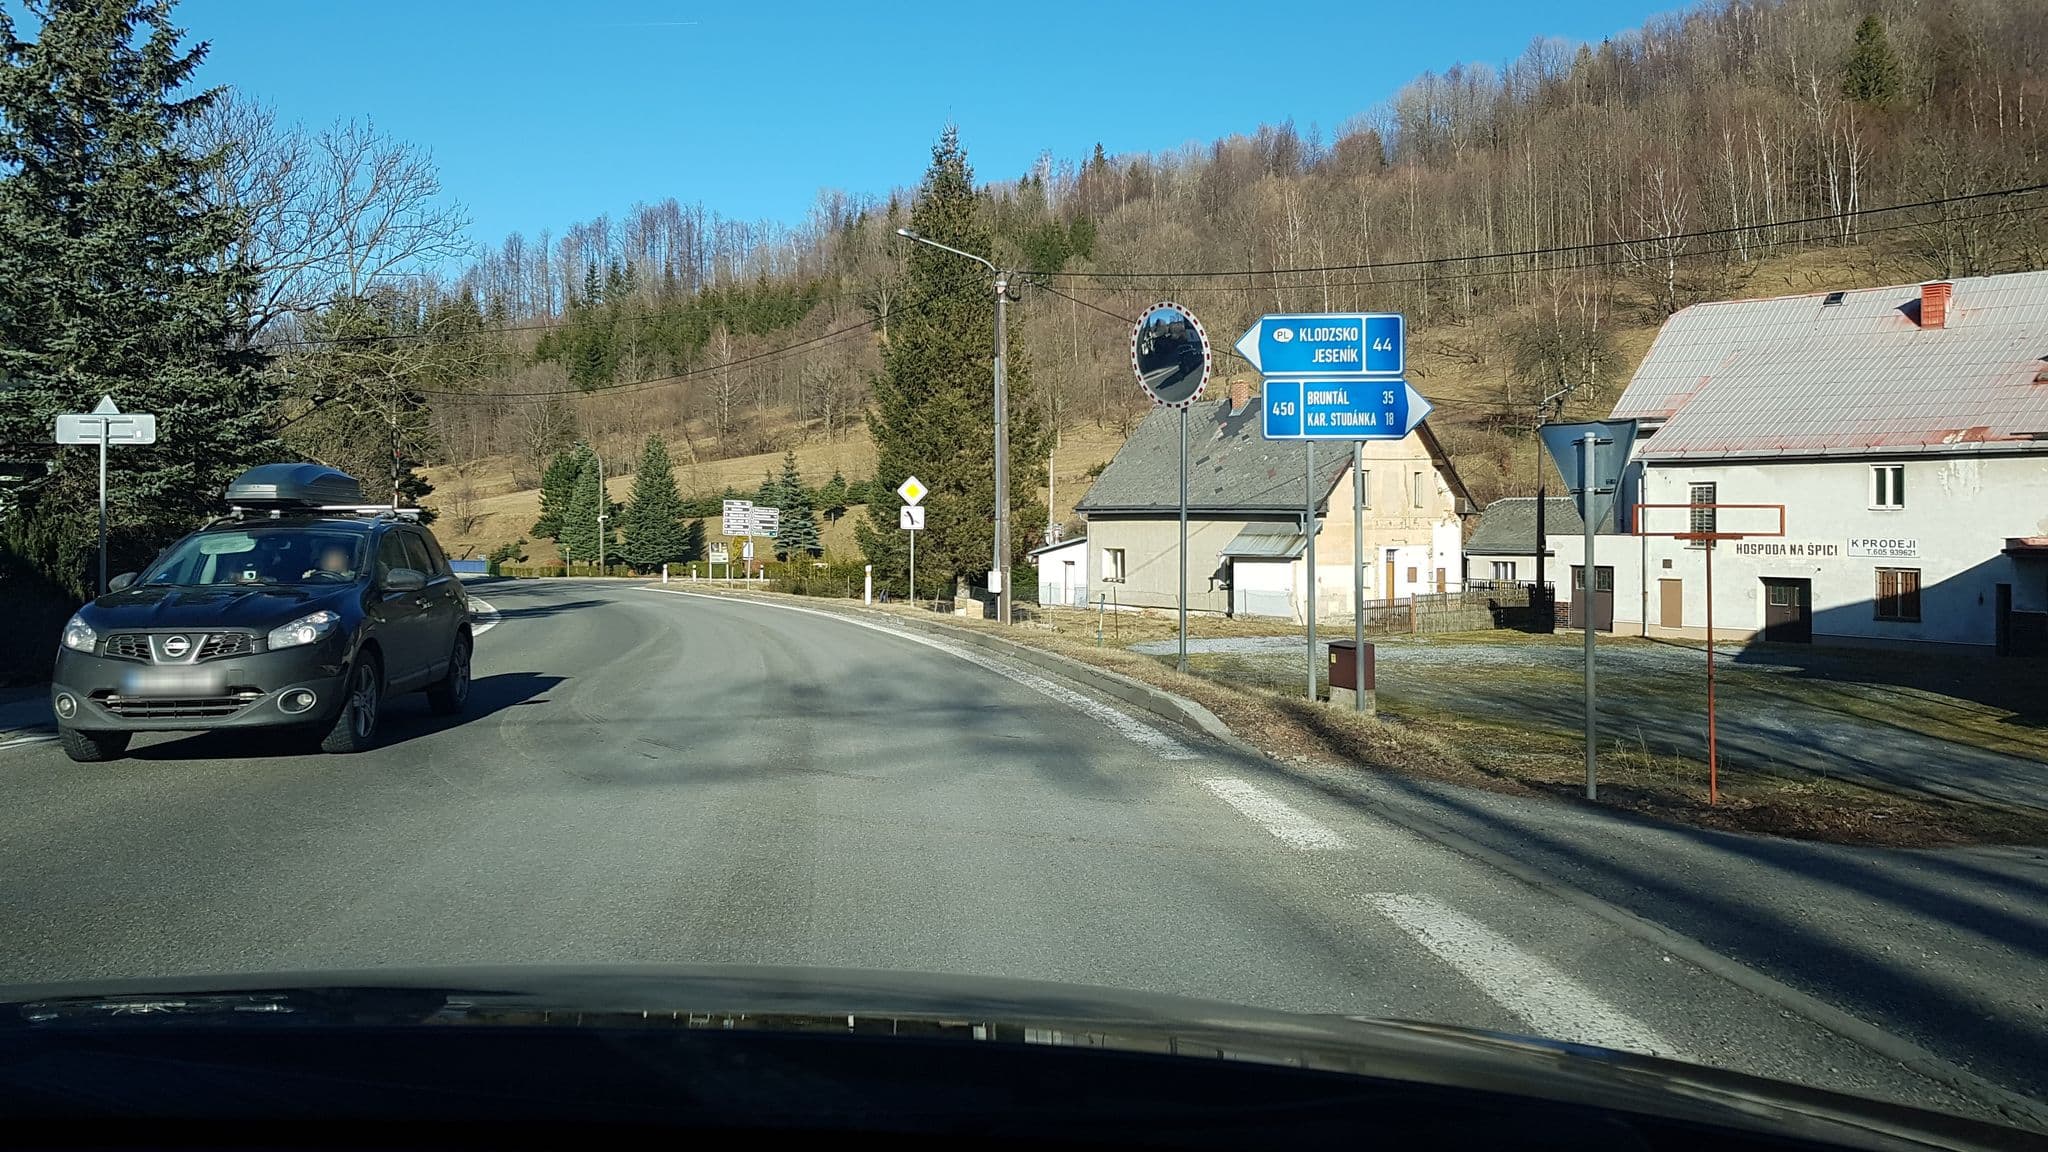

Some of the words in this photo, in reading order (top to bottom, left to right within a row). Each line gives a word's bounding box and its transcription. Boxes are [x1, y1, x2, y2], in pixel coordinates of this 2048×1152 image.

[1276, 331, 1289, 340] PL
[1299, 327, 1358, 342] KLODZSKO
[1373, 338, 1392, 351] 44
[1312, 345, 1358, 363] JESENÍK
[1307, 387, 1349, 405] BRUNTÁL
[1382, 390, 1394, 404] 35
[1272, 402, 1294, 416] 450
[1307, 414, 1328, 427] KAR.
[1330, 409, 1376, 427] STUDÁNKA
[1385, 412, 1394, 426] 18
[1736, 543, 1786, 556] HOSPODA
[1789, 543, 1804, 556] NA
[1851, 539, 1859, 548] K
[1862, 539, 1916, 549] PRODEJI
